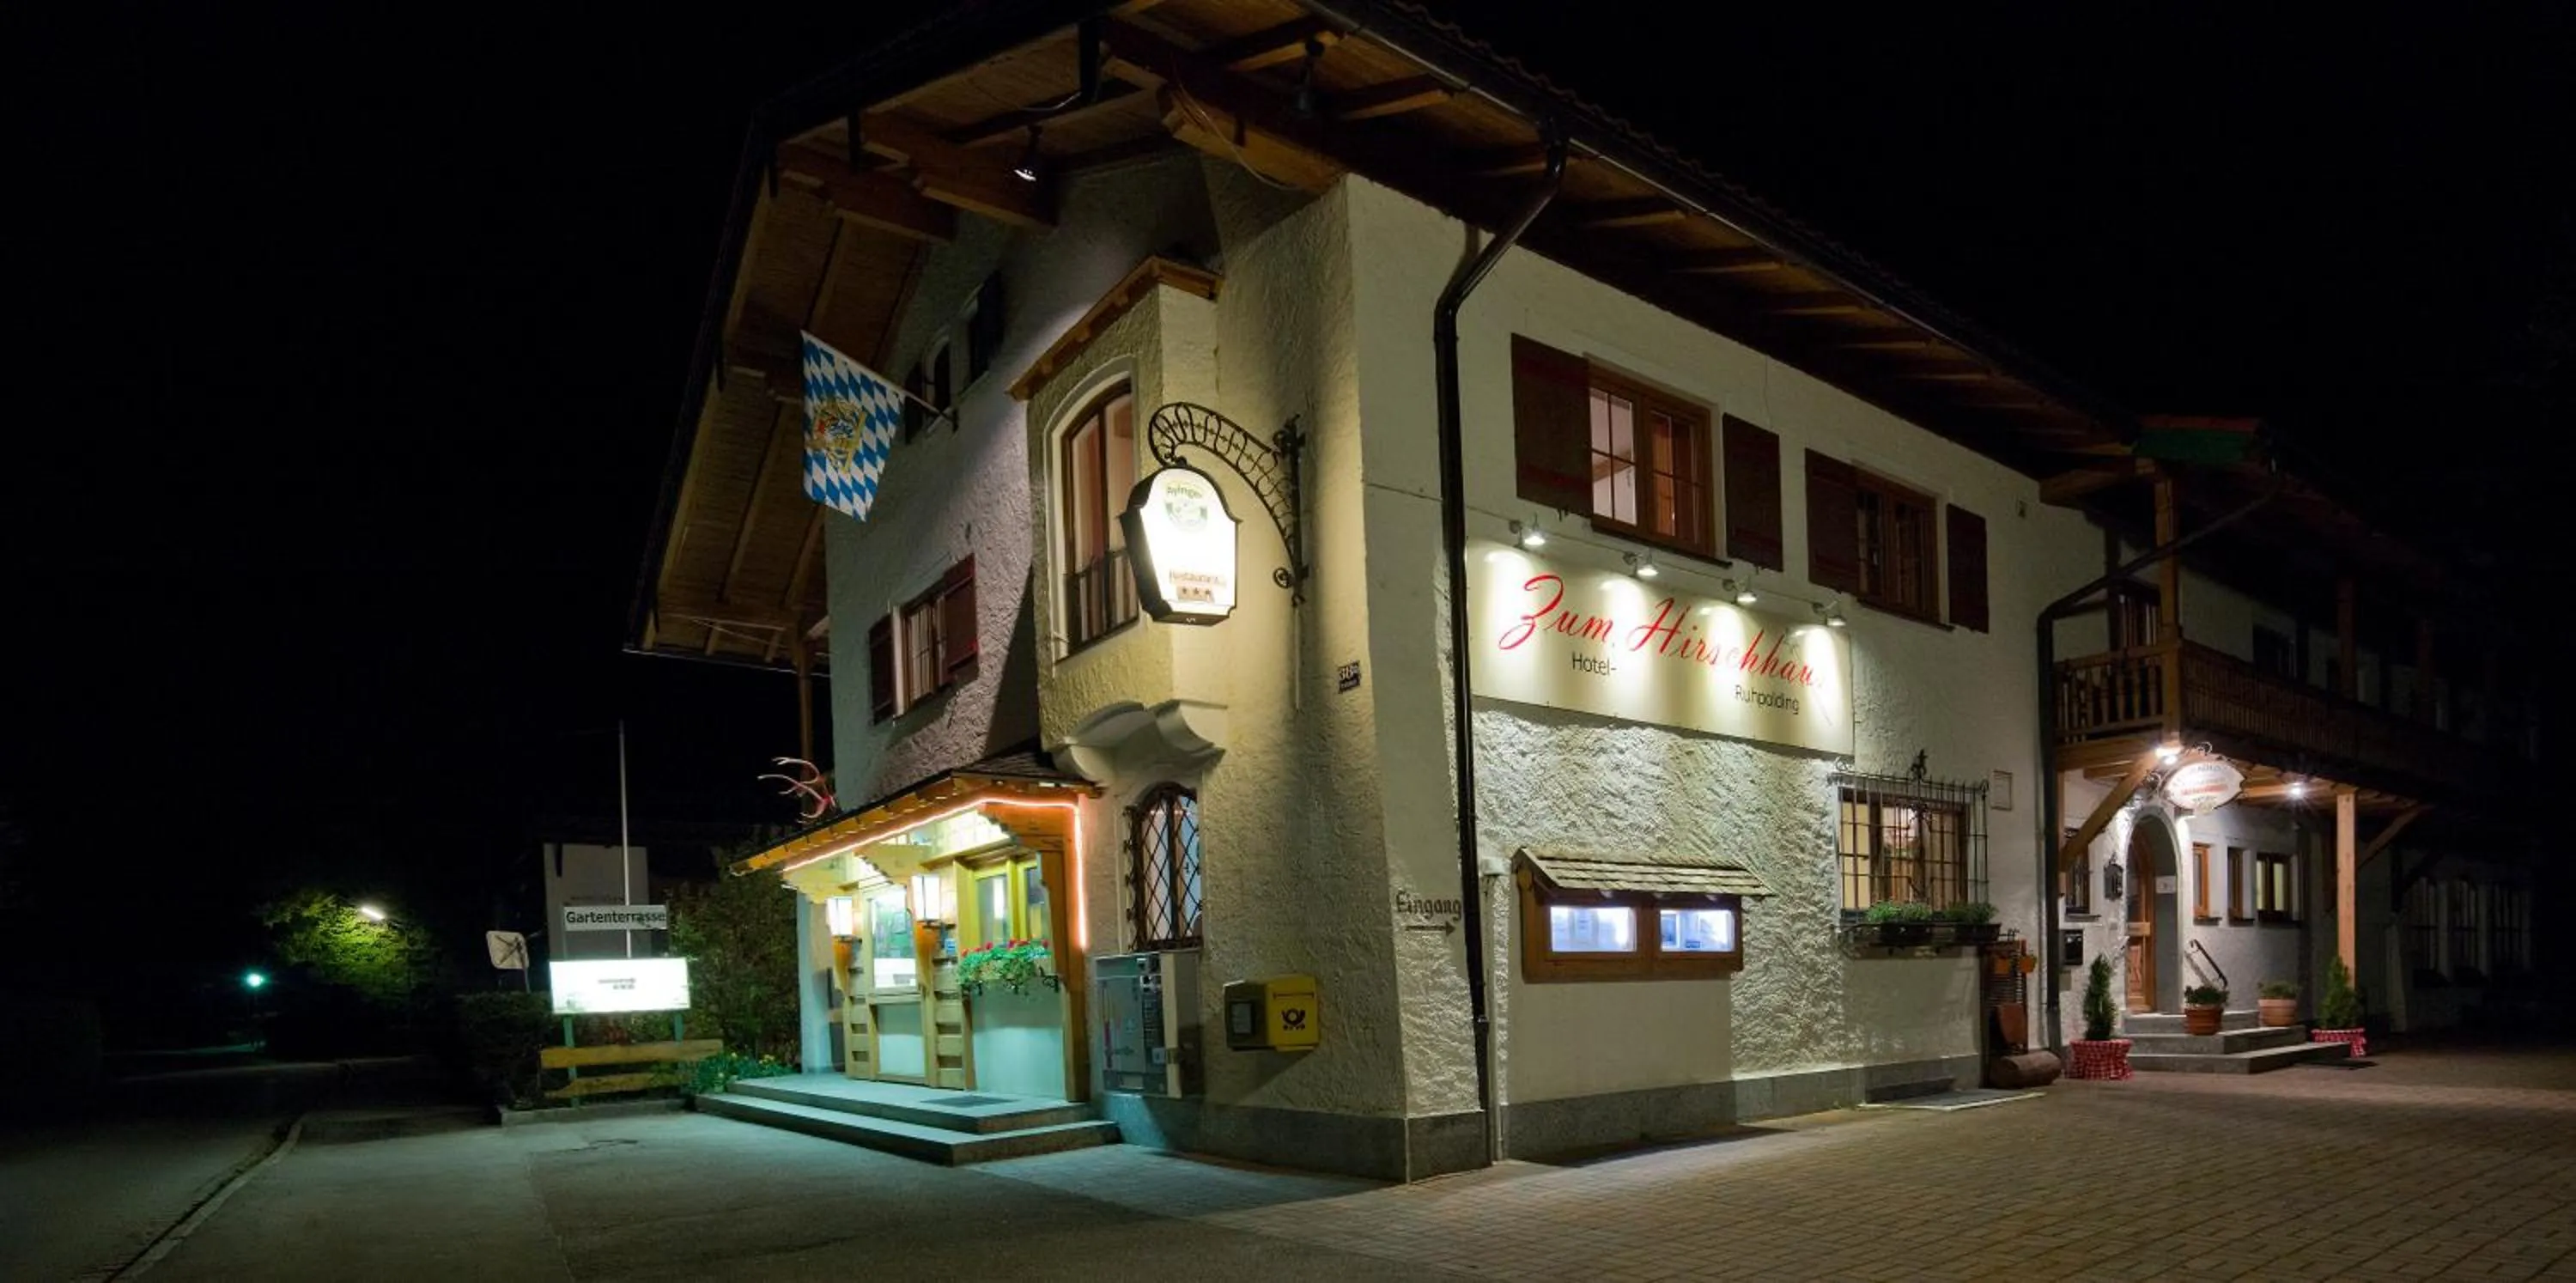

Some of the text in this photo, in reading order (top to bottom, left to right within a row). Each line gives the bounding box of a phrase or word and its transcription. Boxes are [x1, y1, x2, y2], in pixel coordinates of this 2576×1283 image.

[1498, 574, 1614, 650] Zum
[1571, 651, 1617, 677] Hotel-
[1735, 684, 1800, 716] Ruhpolding
[566, 910, 666, 924] Gartenterrasse
[1395, 890, 1461, 922] Eingang
